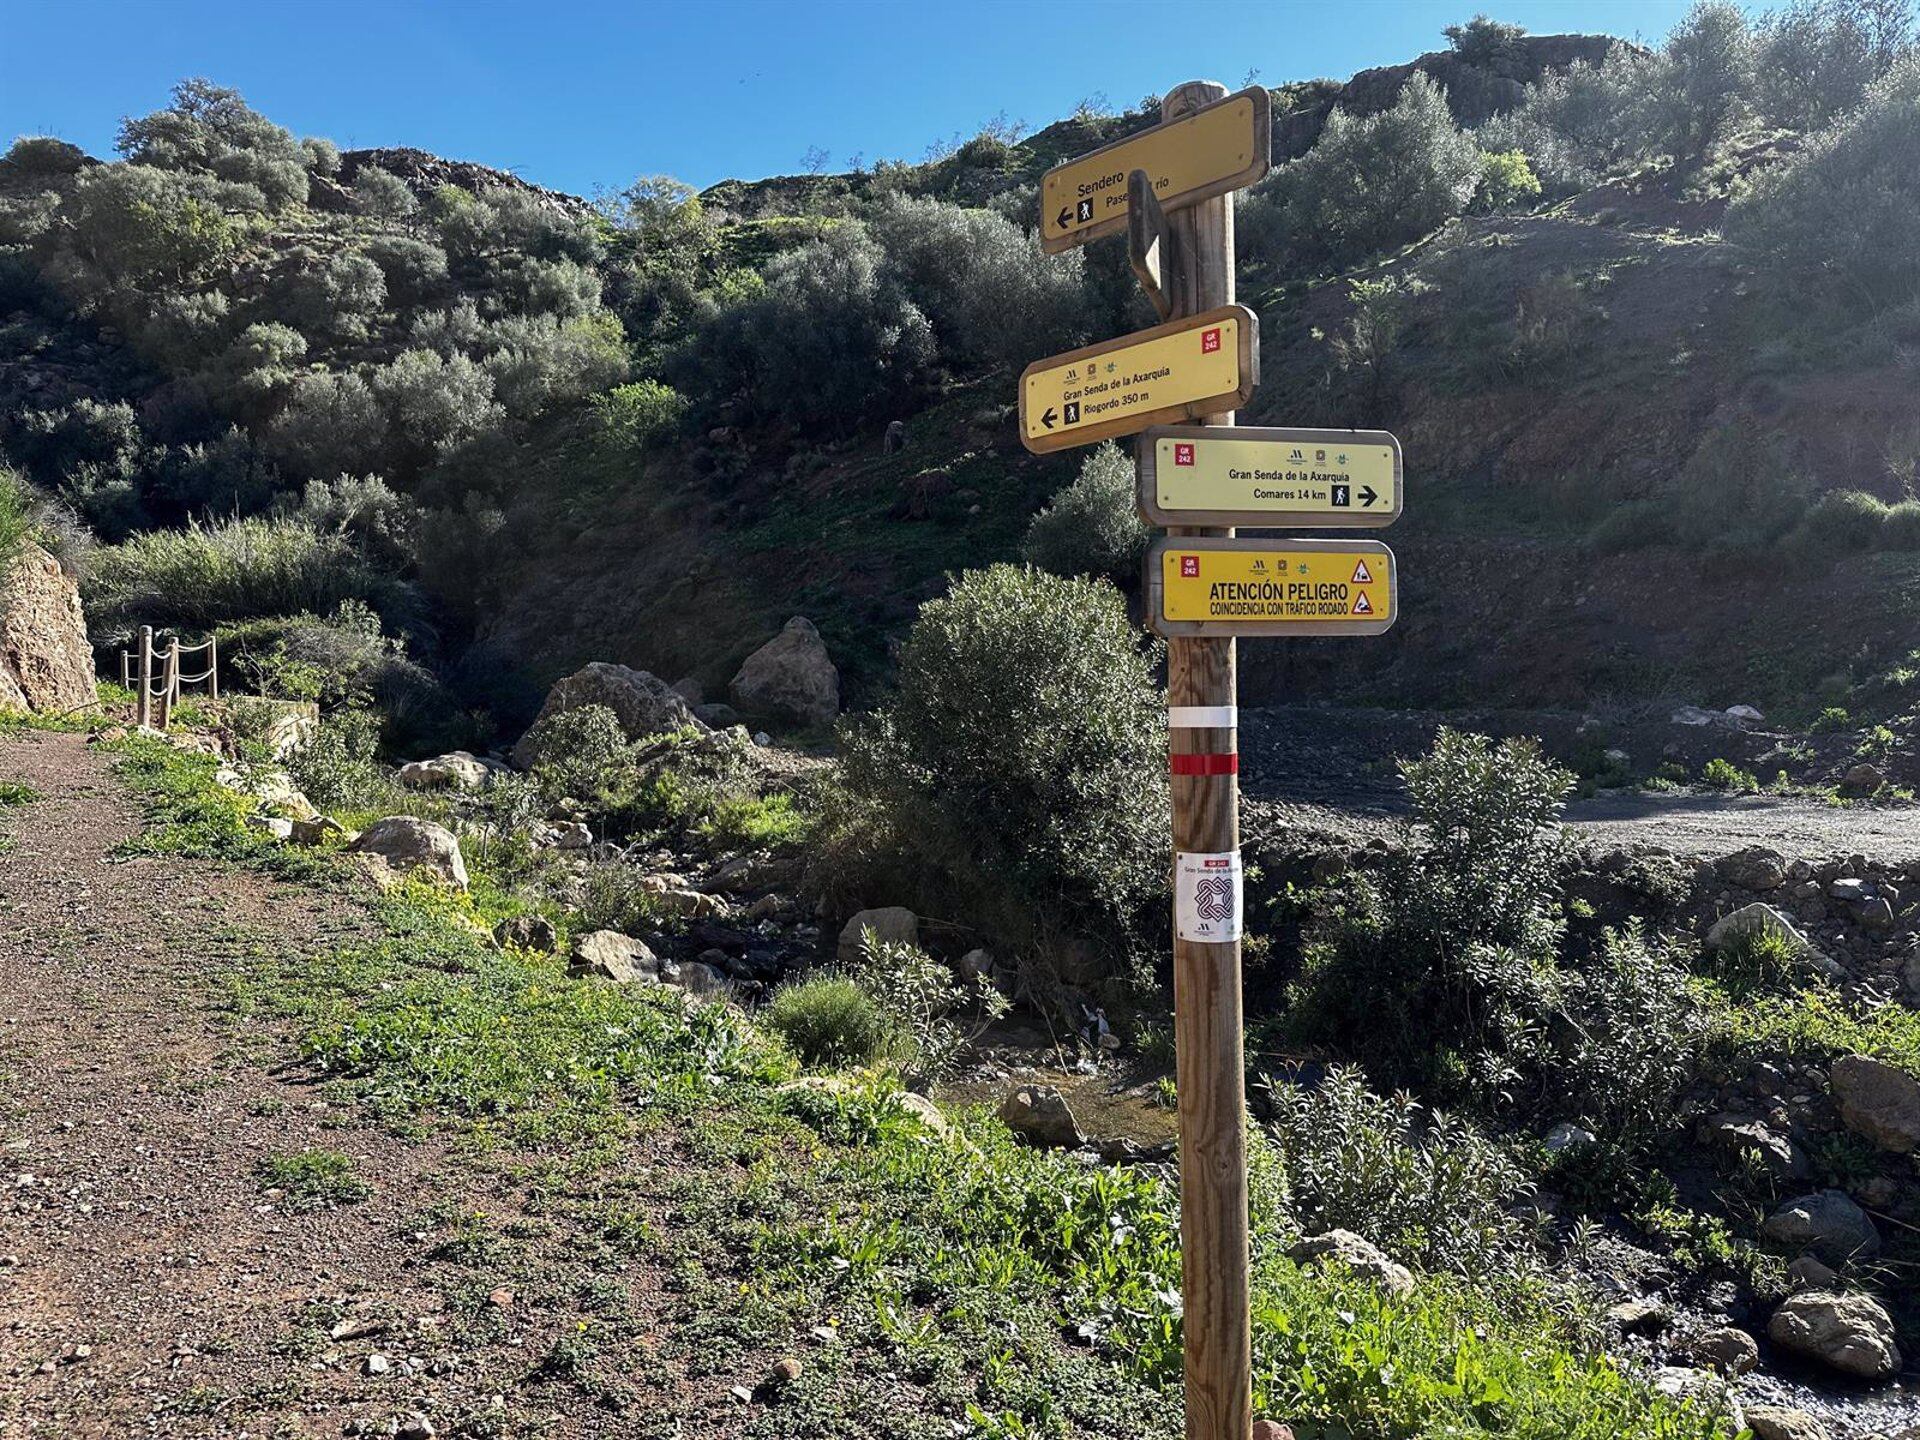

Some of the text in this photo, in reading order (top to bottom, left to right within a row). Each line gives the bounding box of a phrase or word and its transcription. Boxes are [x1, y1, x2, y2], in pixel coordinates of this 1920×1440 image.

[1078, 172, 1124, 197] Sendero
[1064, 390, 1082, 401] Gran
[1084, 382, 1109, 396] Senda
[1110, 379, 1121, 389] de
[1122, 376, 1131, 386] la
[1084, 392, 1149, 415] Riogordo 350 m
[1179, 455, 1191, 463] 242
[1229, 469, 1251, 480] Gran
[1254, 469, 1283, 480] Senda
[1285, 470, 1297, 481] de
[1299, 471, 1308, 481] la
[1253, 488, 1326, 500] Comares 14 km
[1210, 579, 1348, 600] ATENCIÓN PELIGRO
[1210, 602, 1266, 615] COINCIDENCIA
[1267, 602, 1283, 615] CON
[1318, 602, 1348, 615] RODADO
